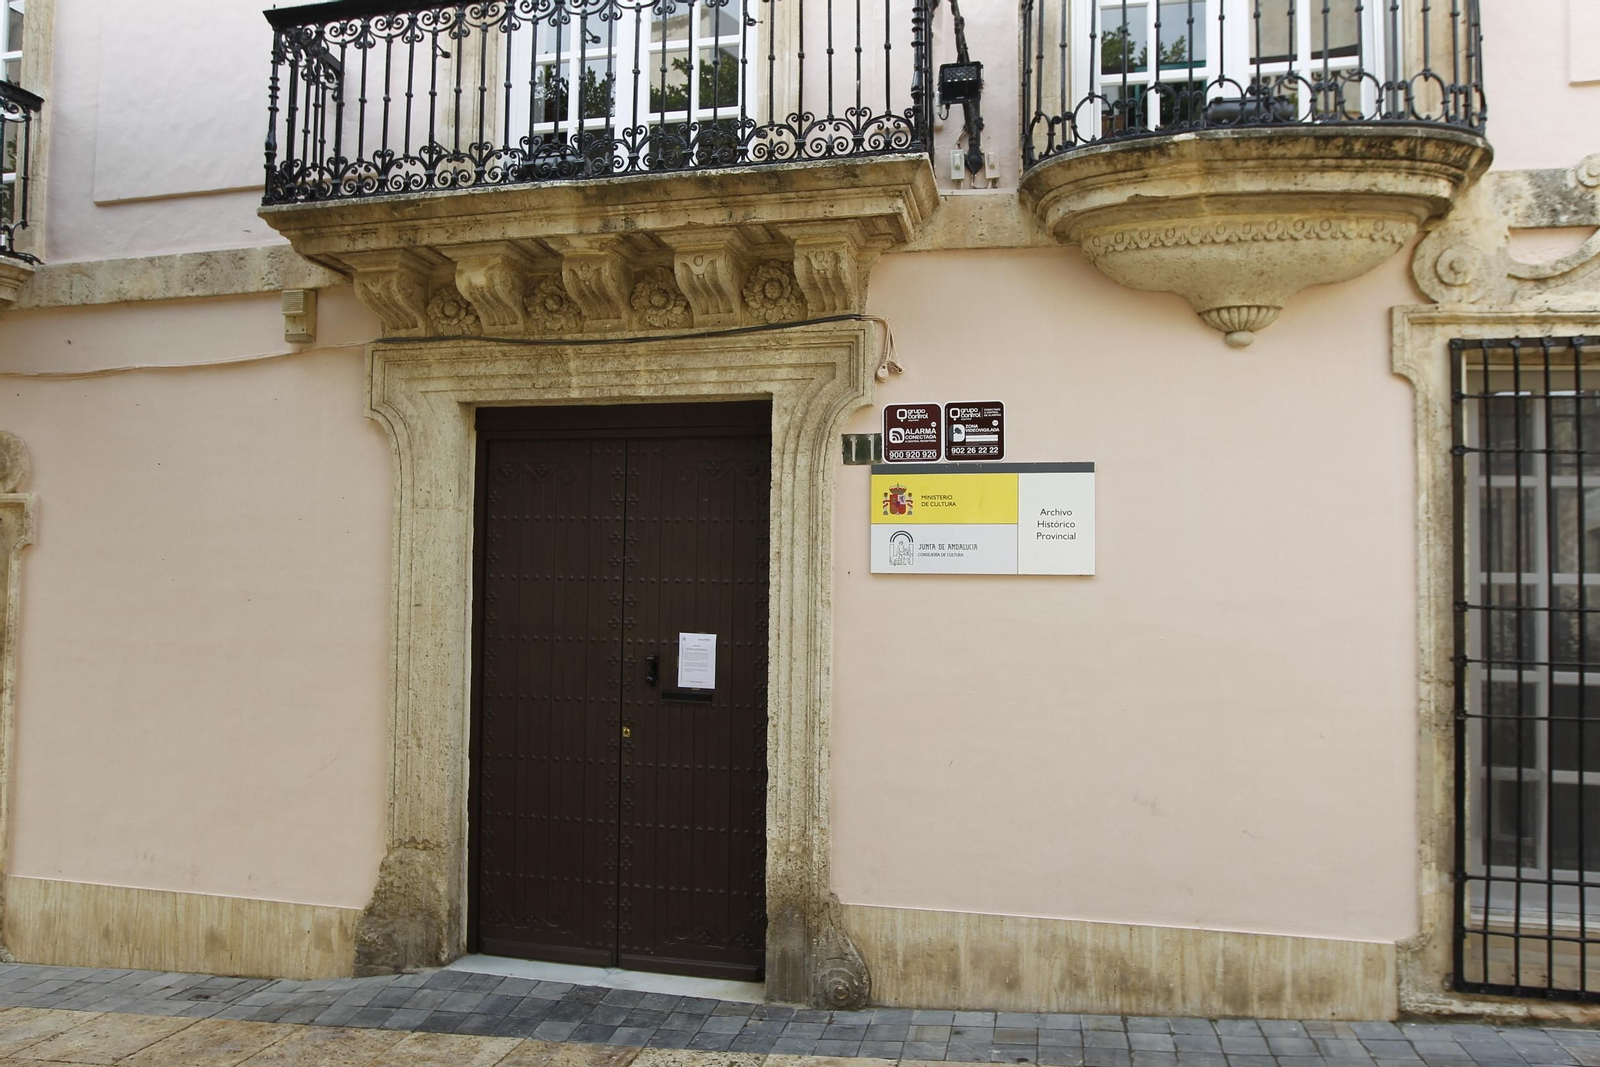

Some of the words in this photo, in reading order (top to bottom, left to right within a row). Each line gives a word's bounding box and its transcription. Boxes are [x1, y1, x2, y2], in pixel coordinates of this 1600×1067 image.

[1040, 508, 1072, 516] Archivo
[1037, 520, 1076, 528] Histórico
[1037, 532, 1076, 540] Provincial
